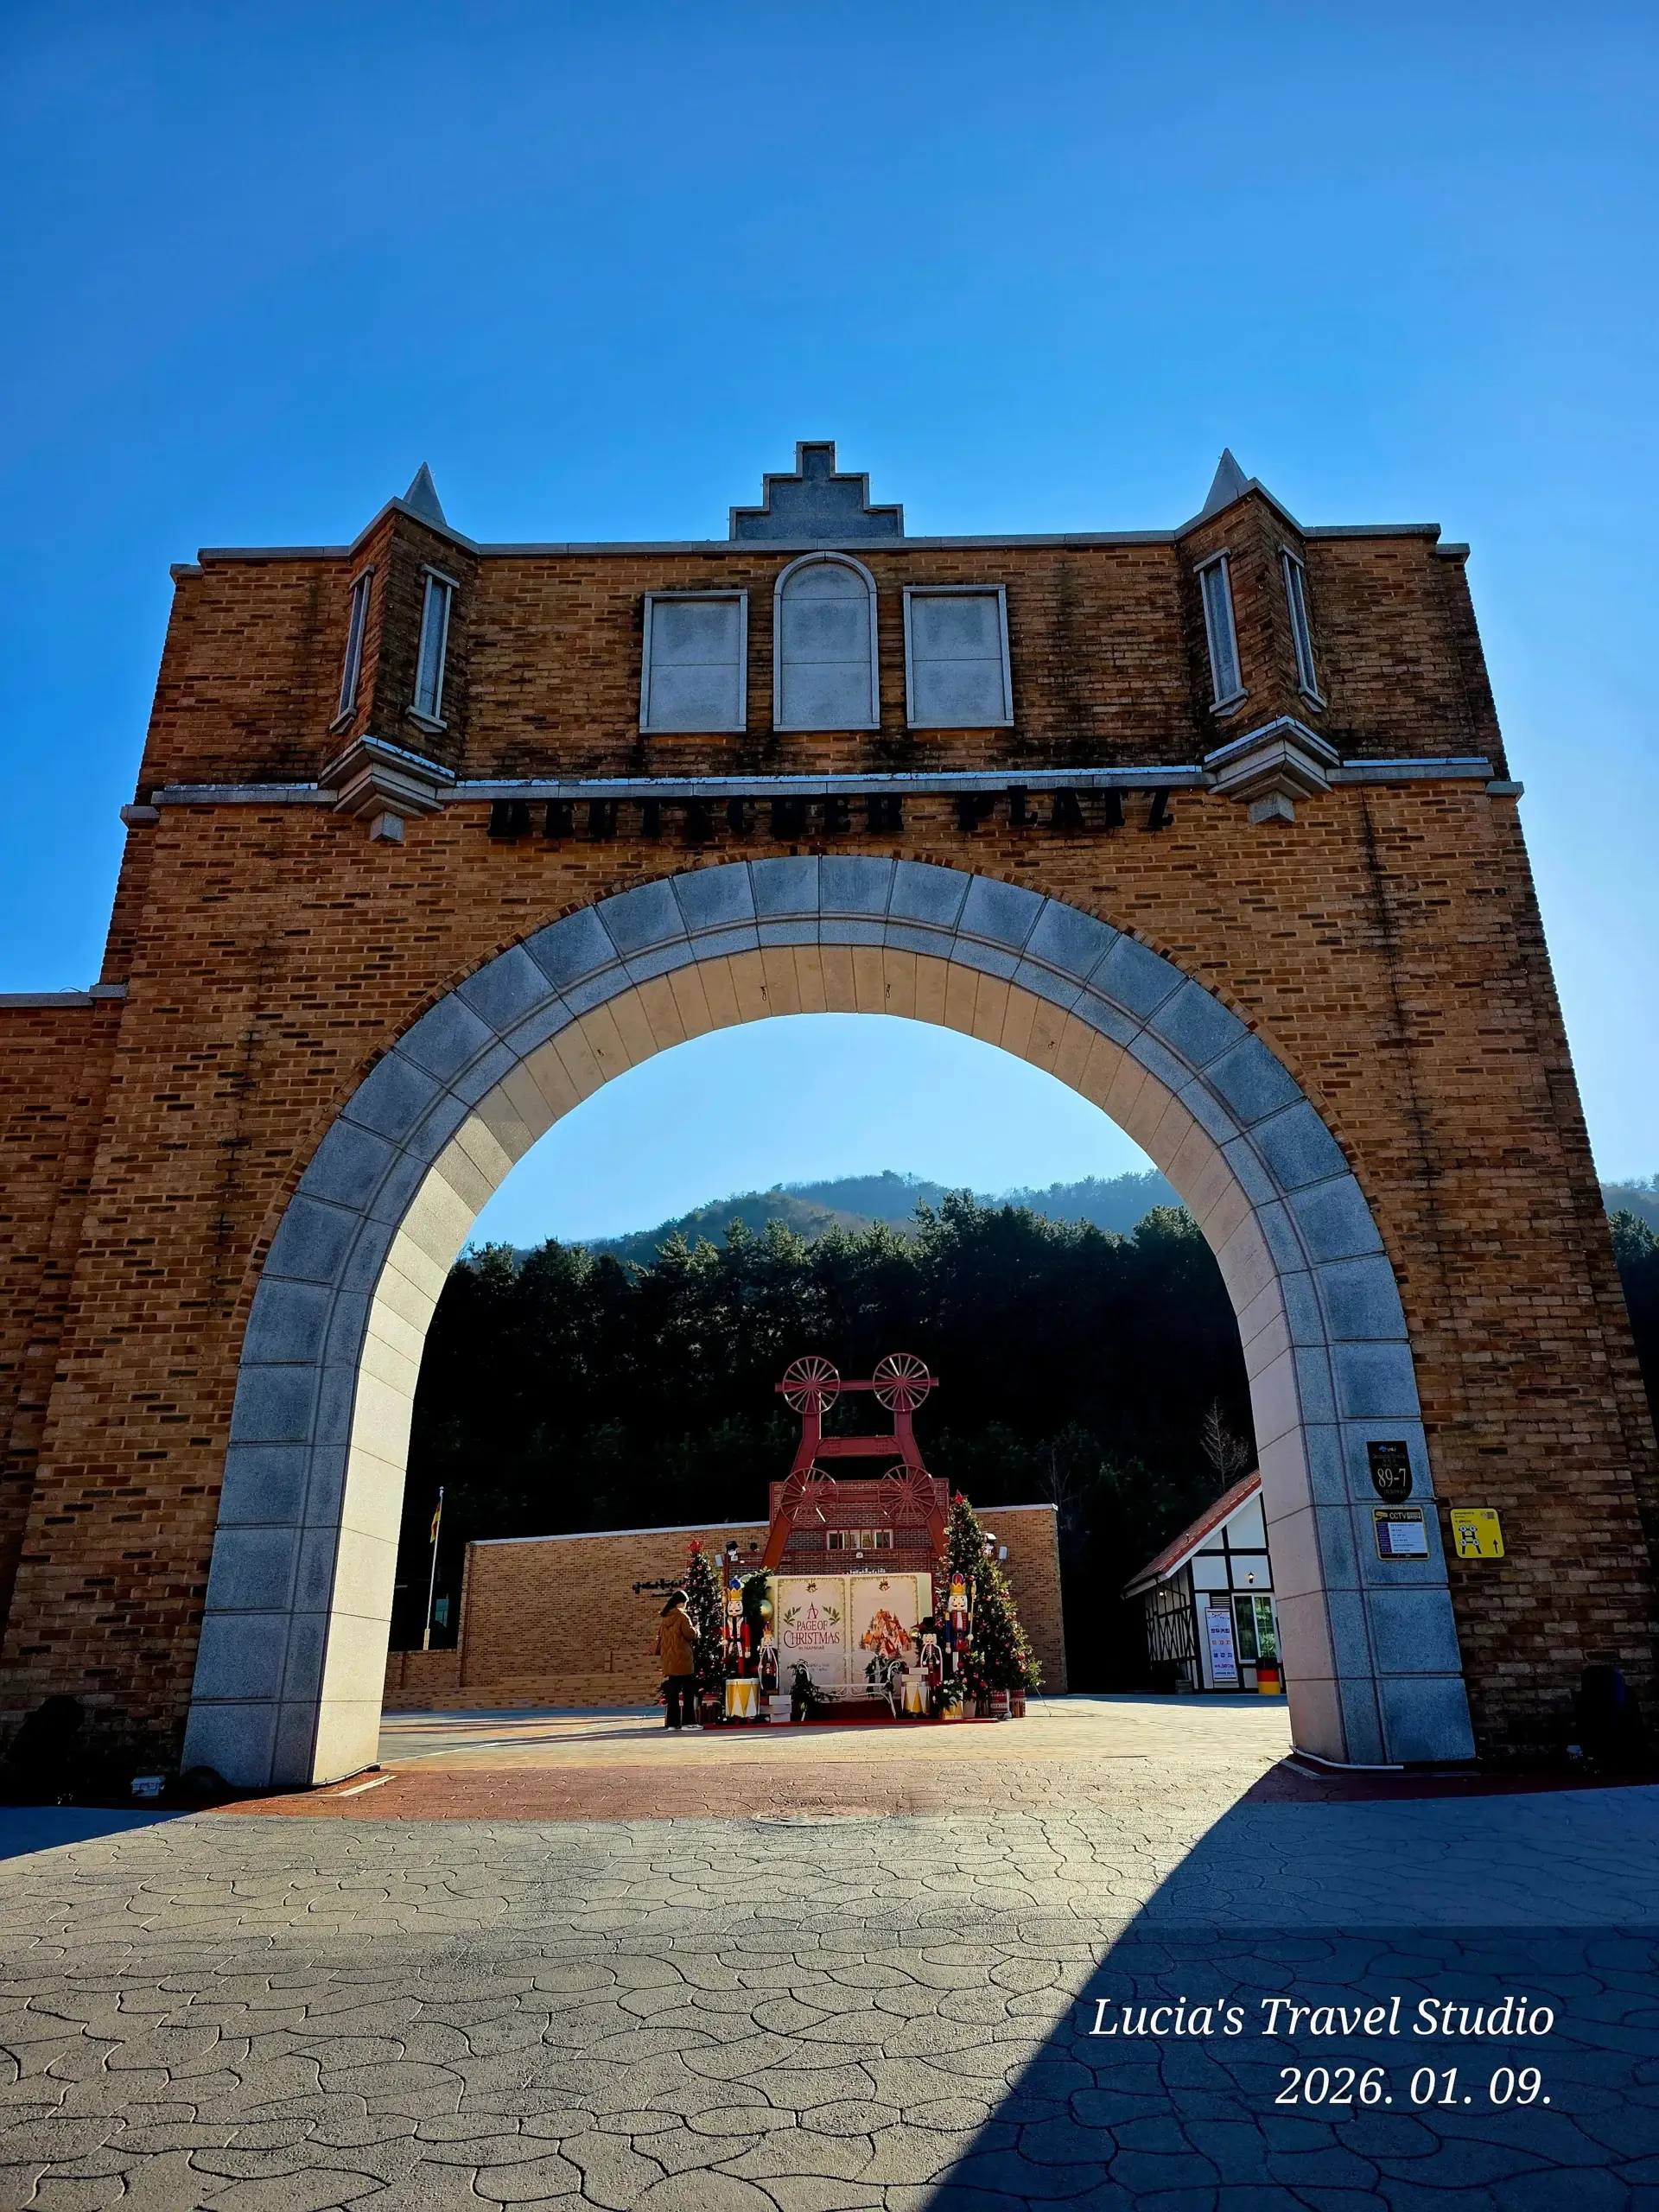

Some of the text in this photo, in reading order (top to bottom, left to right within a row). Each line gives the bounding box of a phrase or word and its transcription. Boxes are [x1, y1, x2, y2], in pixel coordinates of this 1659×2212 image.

[956, 785, 1175, 831] PLATZ
[1377, 1467, 1407, 1488] 89-7
[797, 1620, 829, 1631] PAGE OF
[784, 1630, 840, 1648] CHRISTMAS
